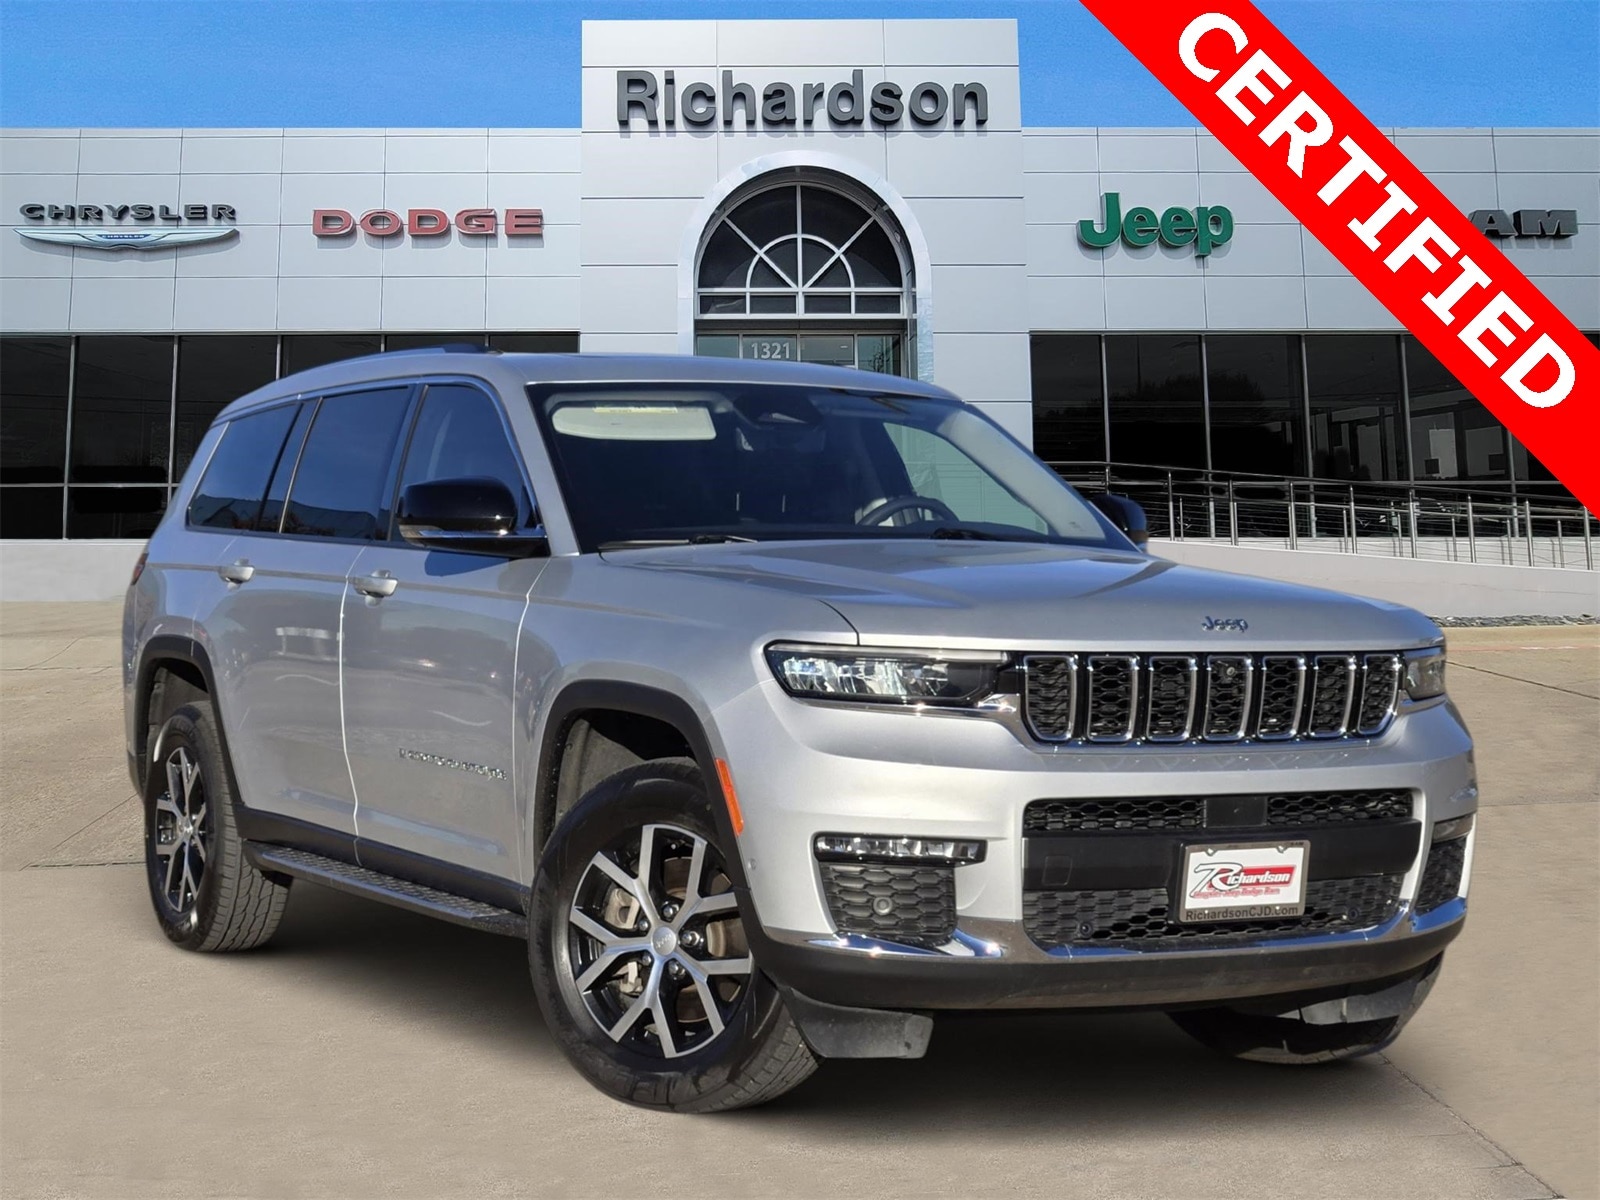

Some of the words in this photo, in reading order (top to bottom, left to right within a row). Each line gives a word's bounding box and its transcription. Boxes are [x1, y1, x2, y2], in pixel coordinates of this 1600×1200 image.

[616, 69, 989, 127] Richardson
[19, 203, 238, 221] CHRYSLER
[312, 208, 544, 238] DODGE
[1077, 192, 1234, 257] Jeep
[1468, 209, 1578, 239] AM
[751, 342, 790, 359] 1321
[1201, 615, 1248, 633] Jeep
[1190, 862, 1291, 898] Richardson
